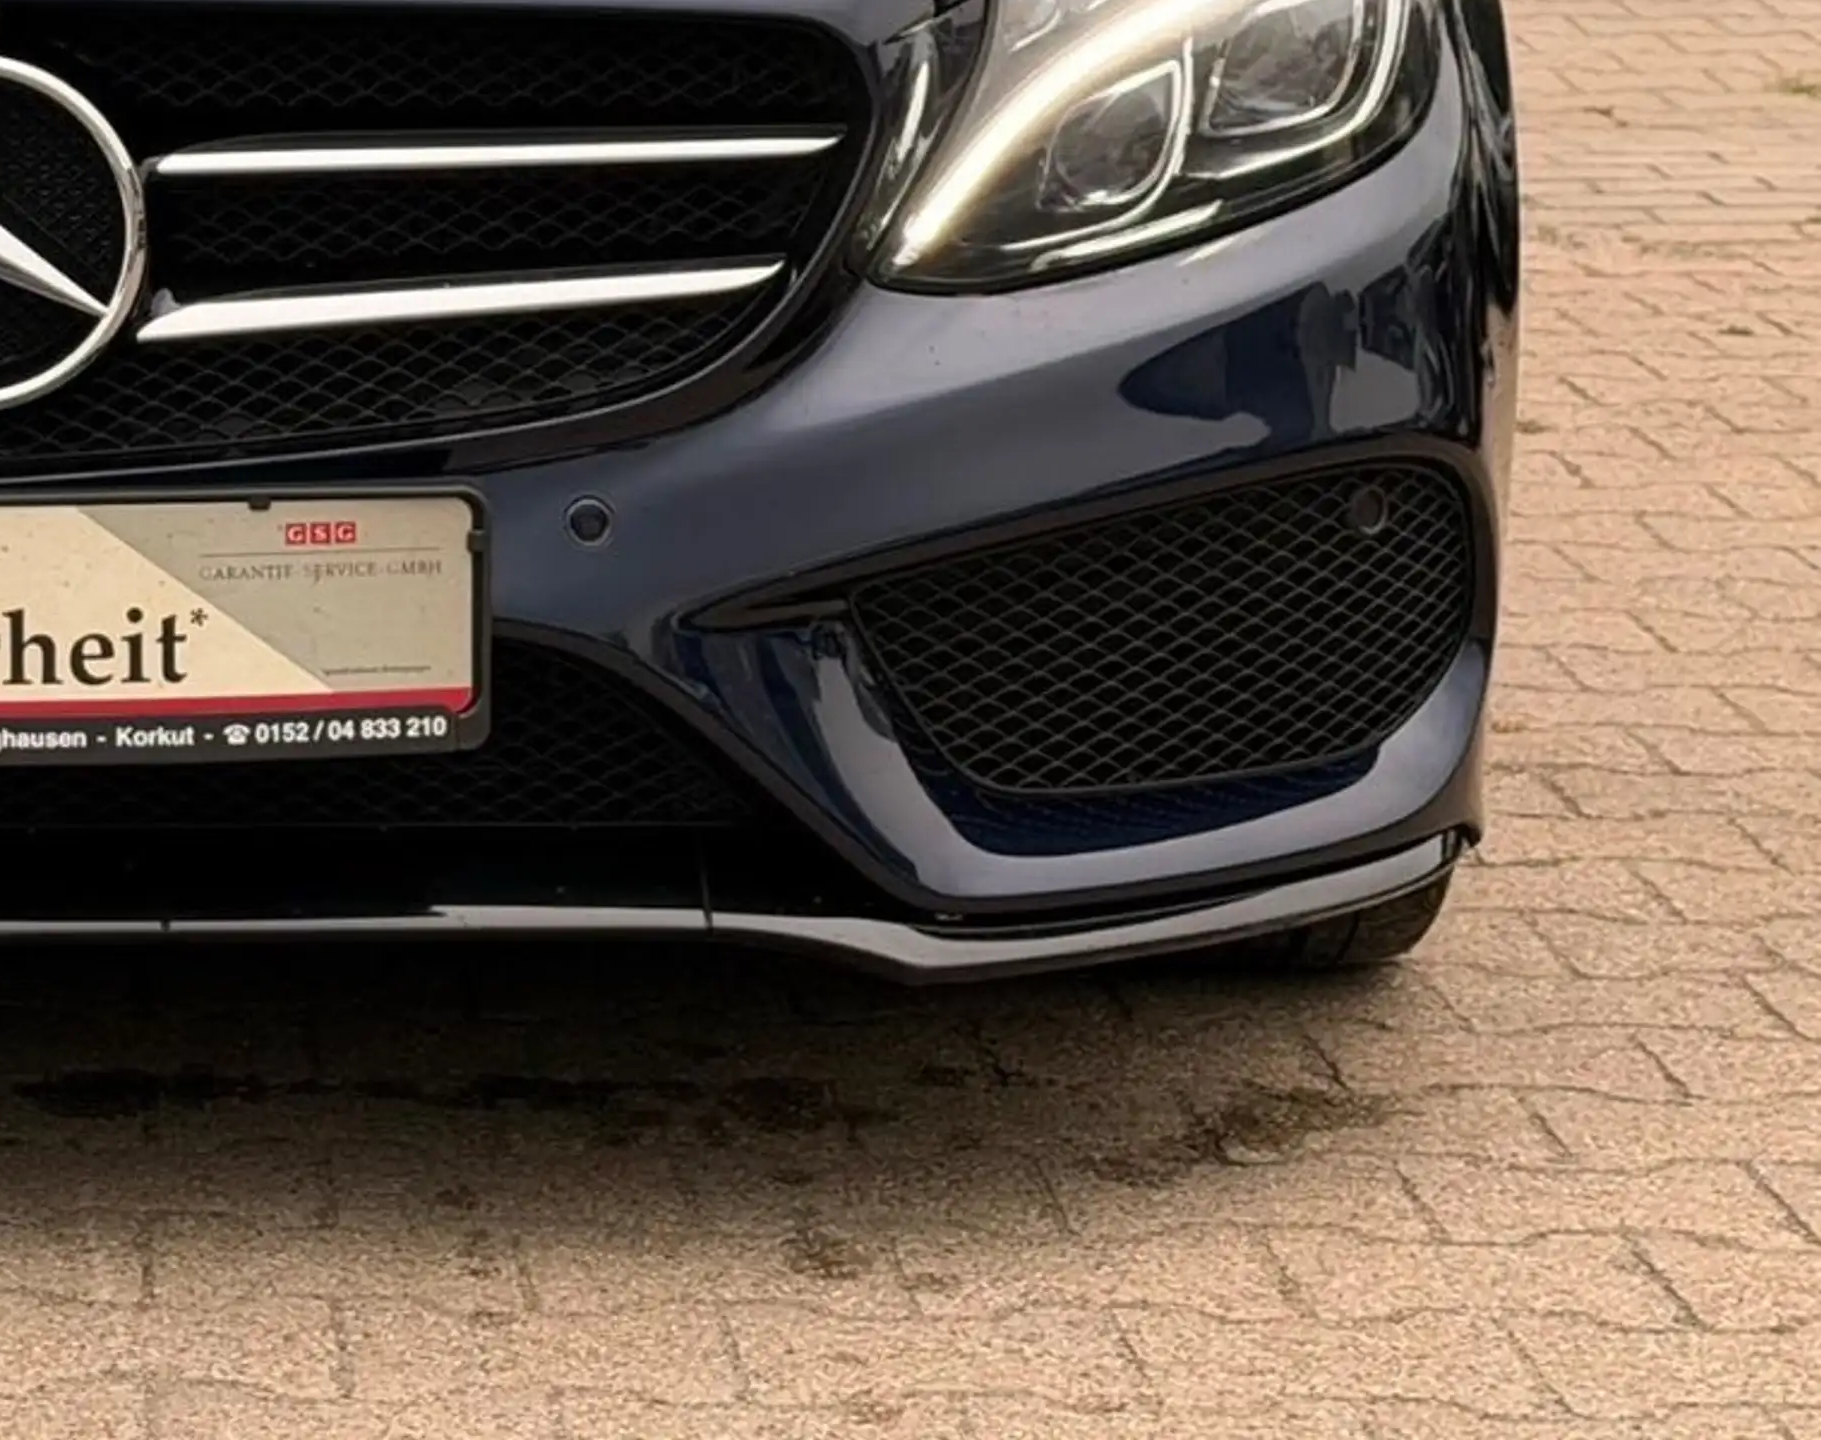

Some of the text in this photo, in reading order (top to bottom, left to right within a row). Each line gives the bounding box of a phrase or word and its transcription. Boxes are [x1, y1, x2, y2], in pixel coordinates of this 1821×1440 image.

[286, 523, 356, 545] GSG
[115, 726, 195, 748] Korkut
[255, 722, 310, 744] 0152
[360, 717, 401, 739] 833
[406, 715, 447, 738] 210
